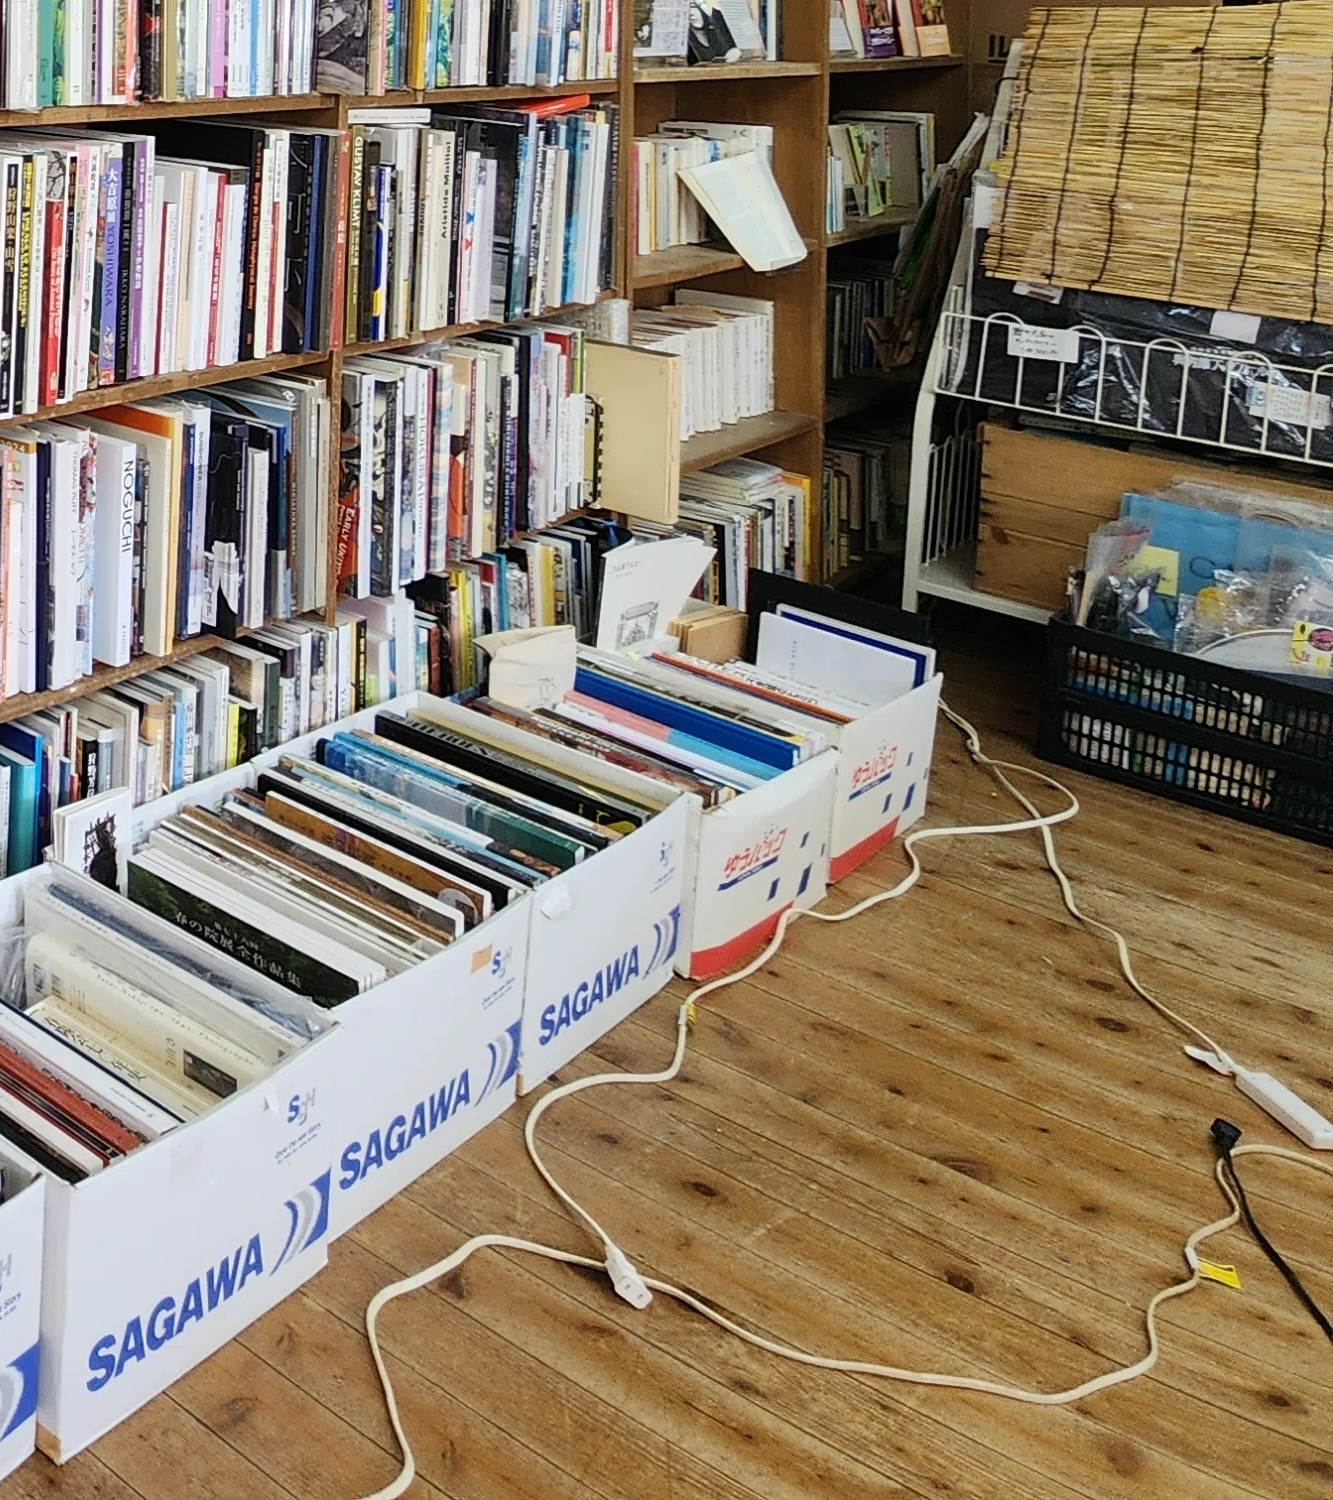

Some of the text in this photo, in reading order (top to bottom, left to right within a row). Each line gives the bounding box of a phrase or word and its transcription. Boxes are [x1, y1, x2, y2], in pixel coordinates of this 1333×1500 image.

[106, 167, 119, 224] 大吉原展
[351, 135, 364, 230] GUSTAV KLIMT
[440, 140, 452, 240] Aristide Maillol
[121, 459, 134, 555] NOGUCHI
[537, 945, 642, 1047] SAGAWA
[337, 1068, 472, 1191] SAGAWA
[85, 1234, 265, 1393] SAGAWA
